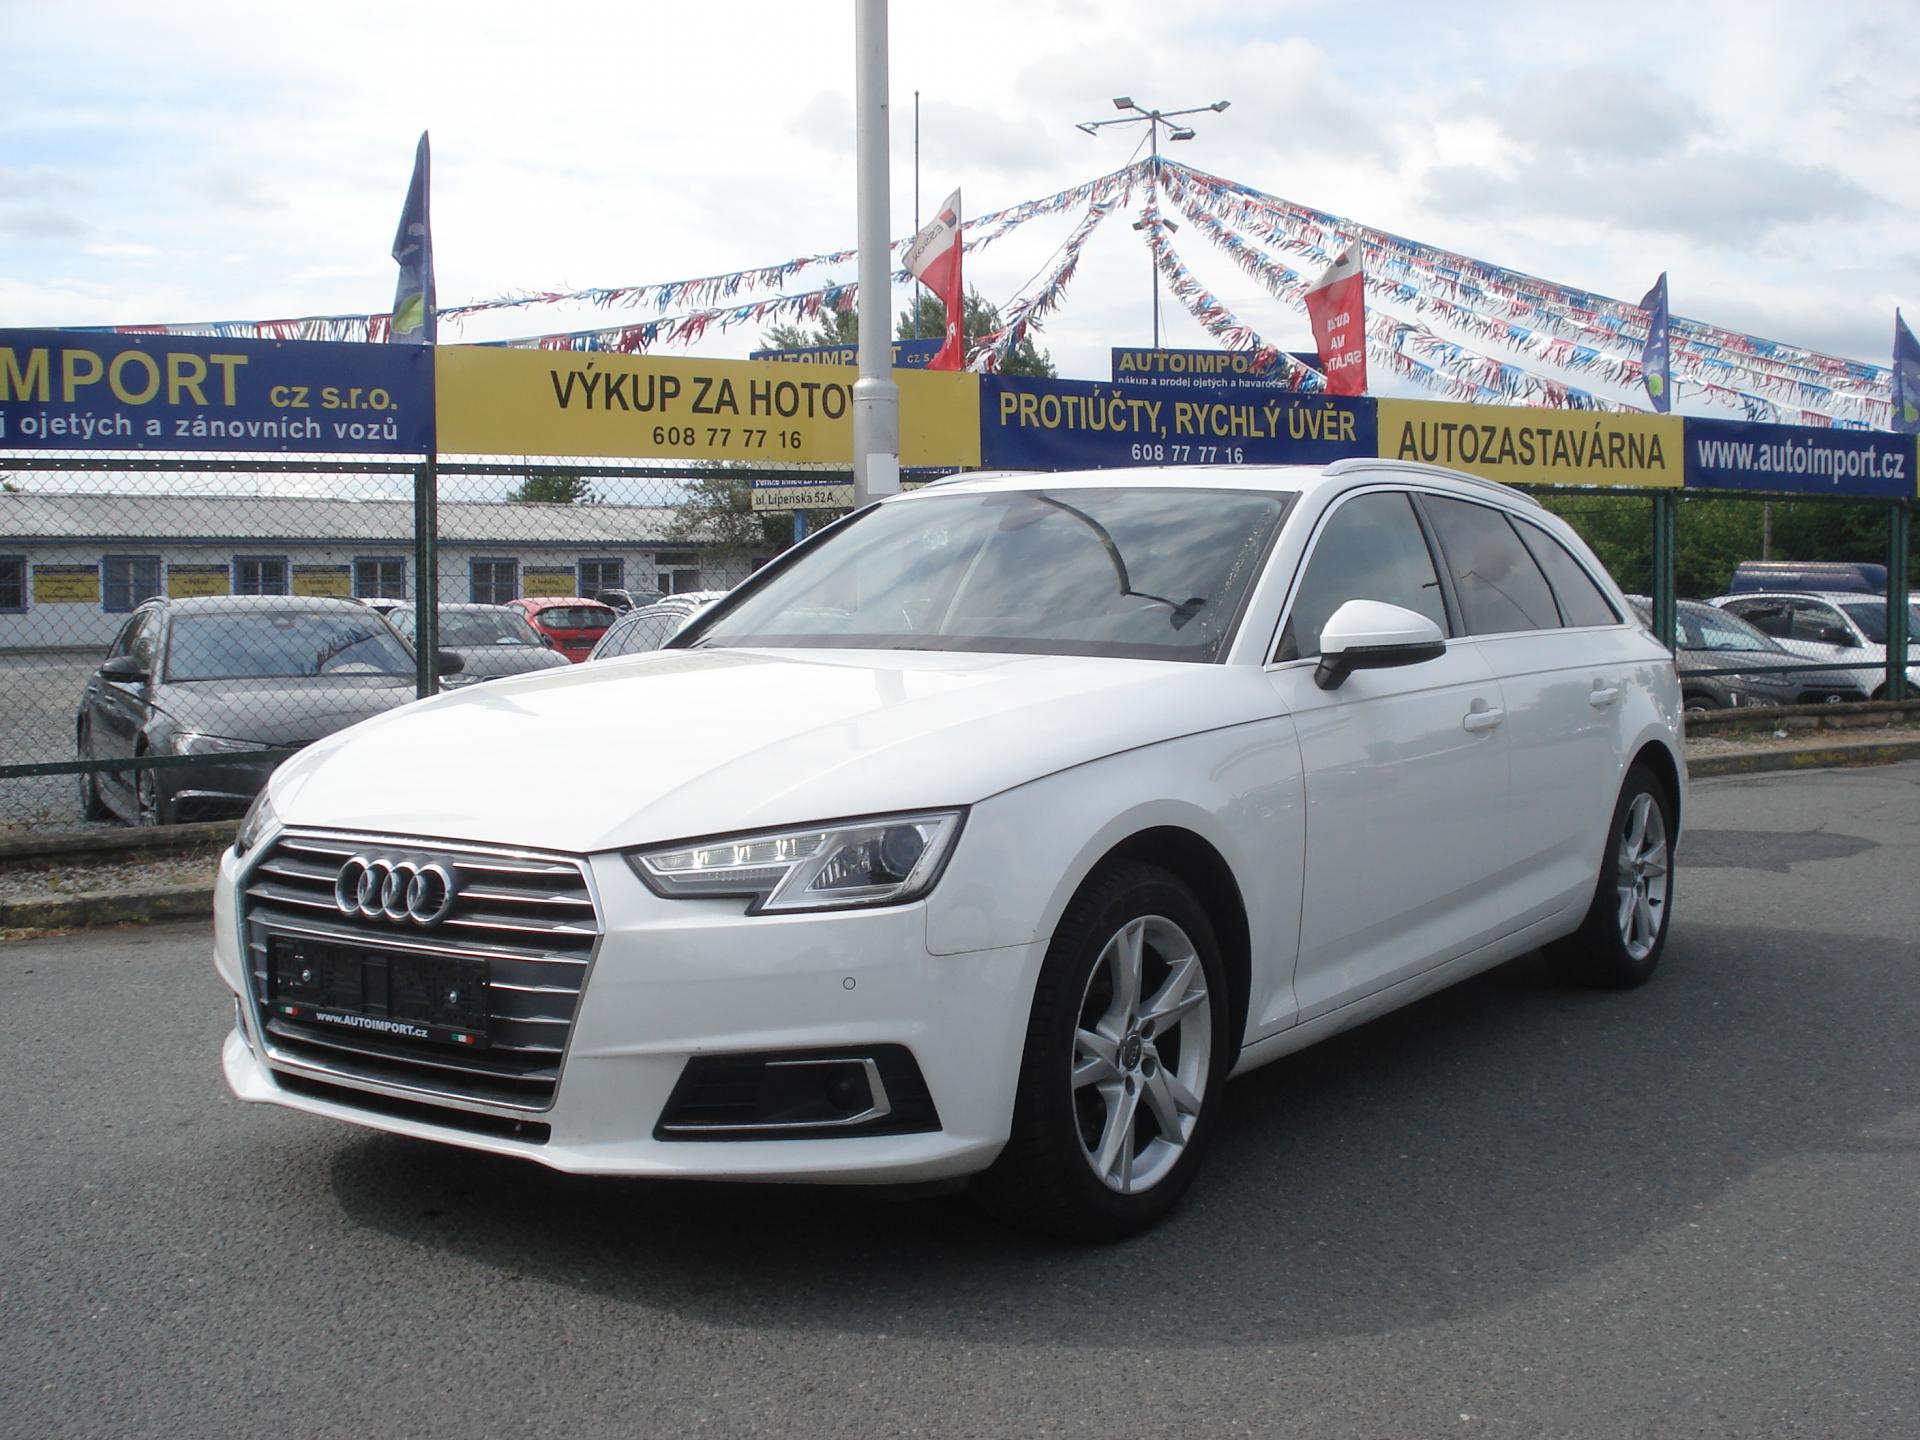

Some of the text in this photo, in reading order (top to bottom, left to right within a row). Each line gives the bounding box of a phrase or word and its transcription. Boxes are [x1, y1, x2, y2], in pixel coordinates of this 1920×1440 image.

[1118, 351, 1265, 374] AUTOIMPO
[0, 347, 398, 410] MPORT cz s.r.o.
[550, 362, 681, 412] VÝKUP
[692, 377, 739, 415] ZA
[1159, 377, 1191, 387] prodej
[1193, 377, 1228, 389] ojetých
[20, 411, 132, 440] ojetých
[146, 418, 162, 436] a
[176, 414, 321, 440] zánovních
[334, 416, 398, 440] vozů
[1000, 389, 1357, 442] PROTIÚČTY, RYCHLÝ ÚVĚR
[653, 426, 801, 449] 608 77 77 16
[1398, 420, 1666, 469] AUTOZASTAVÁRNA
[1131, 443, 1244, 464] 608 77 77 16
[1697, 437, 1906, 485] www.autoimport.cz
[768, 491, 813, 507] Lipenská
[316, 1012, 429, 1038] www.AUTOIMPORT.cz
